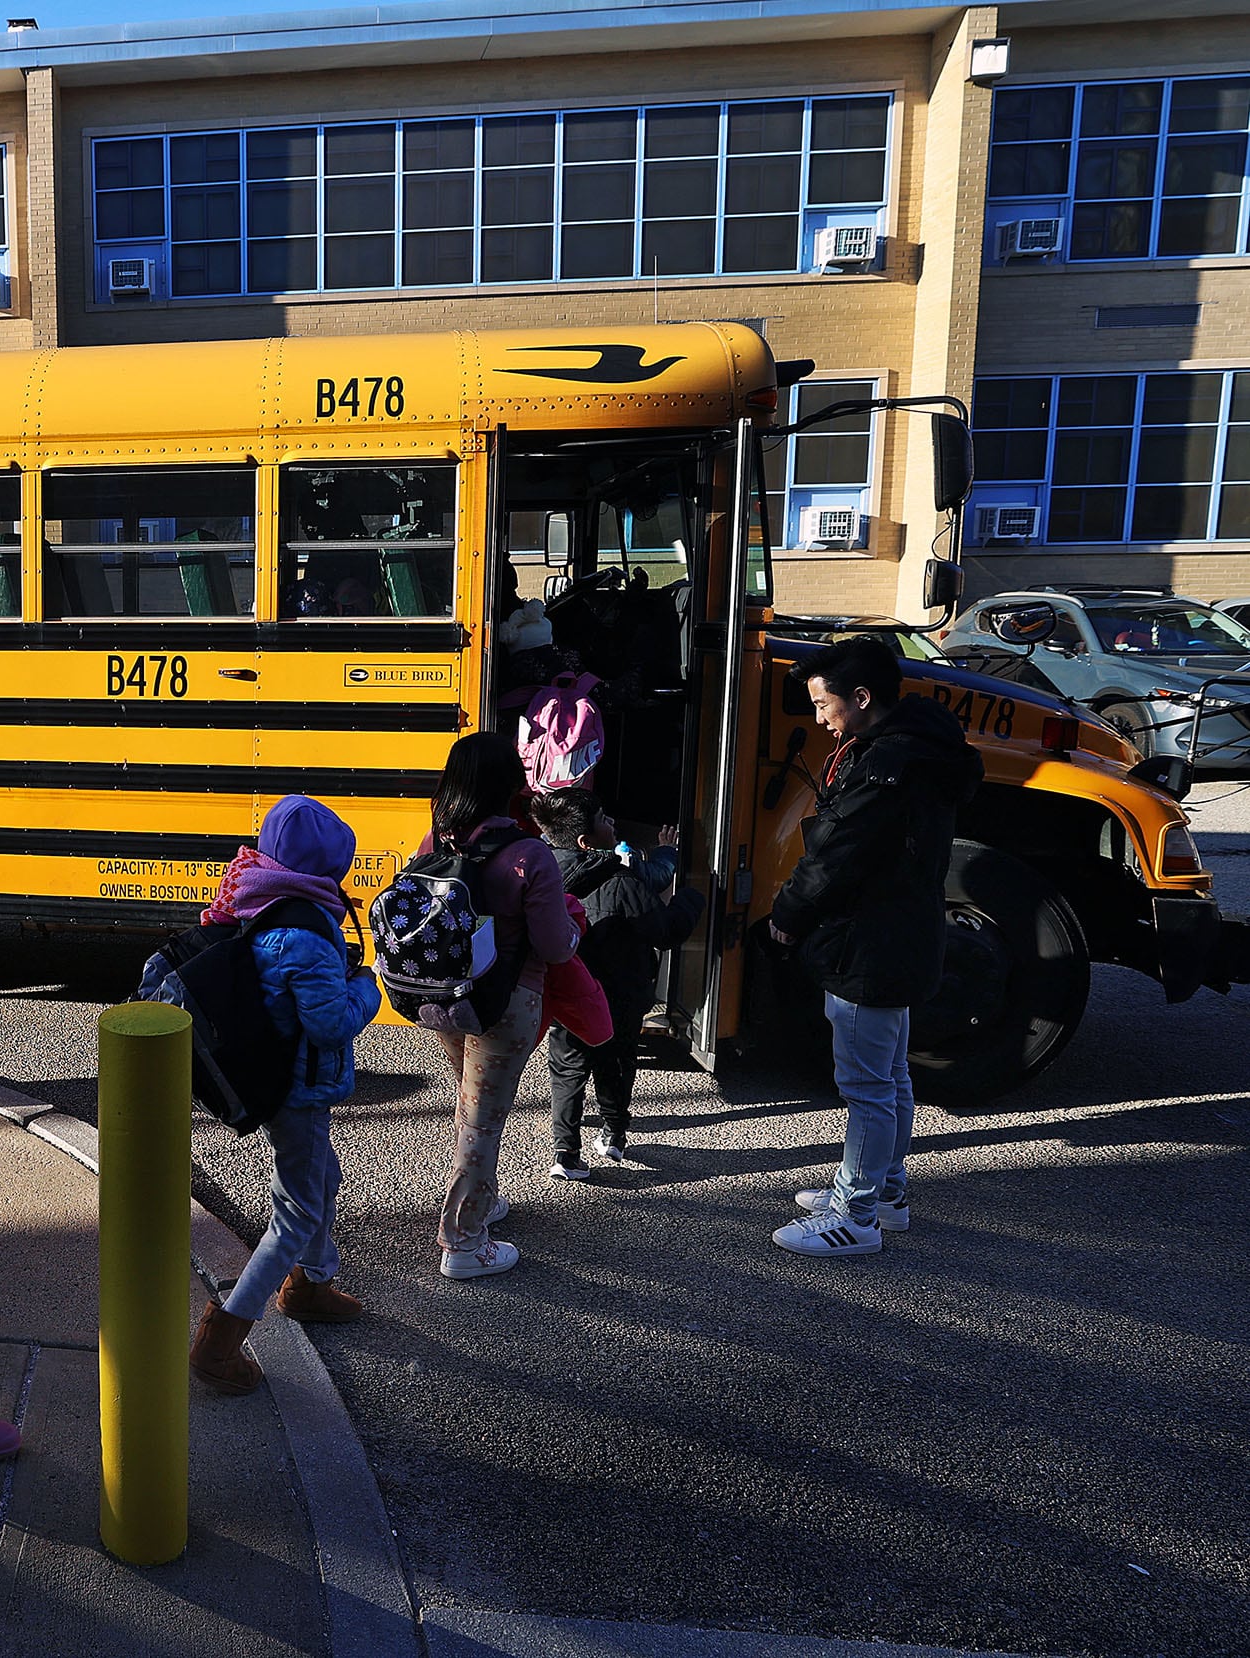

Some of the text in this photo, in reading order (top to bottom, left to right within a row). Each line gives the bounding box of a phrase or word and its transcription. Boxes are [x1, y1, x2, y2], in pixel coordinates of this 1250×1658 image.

[316, 376, 404, 418] B478
[106, 655, 188, 698] B478
[375, 670, 407, 681] BLUE
[549, 739, 601, 782] NIKE
[98, 860, 157, 875] CAPACITY:
[161, 862, 173, 876] 71
[185, 863, 202, 877] 13"
[354, 857, 384, 870] D.E.F.
[353, 874, 384, 888] ONLY
[100, 883, 146, 898] OWNER:
[150, 885, 198, 900] BOSTON
